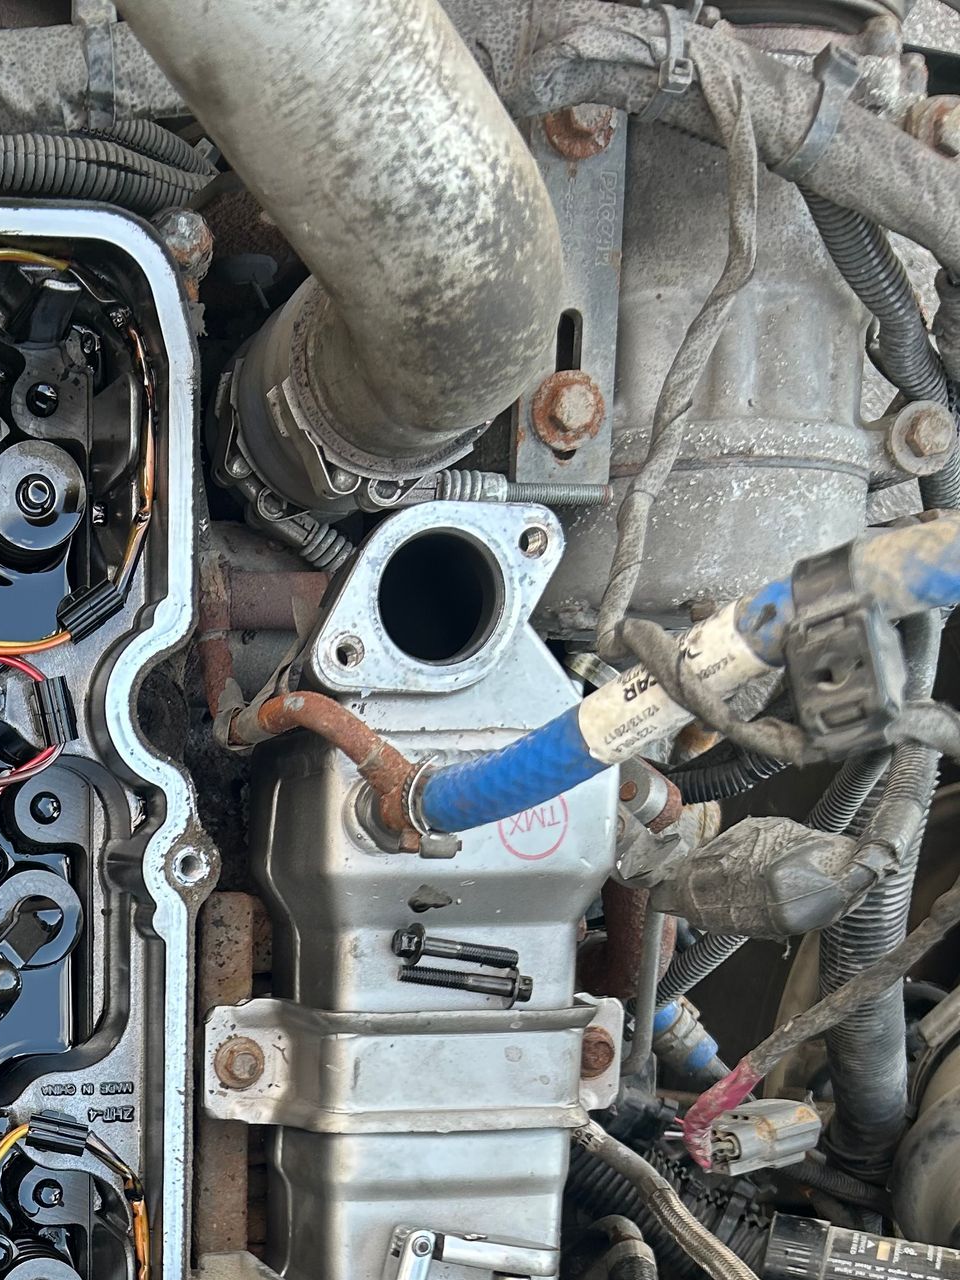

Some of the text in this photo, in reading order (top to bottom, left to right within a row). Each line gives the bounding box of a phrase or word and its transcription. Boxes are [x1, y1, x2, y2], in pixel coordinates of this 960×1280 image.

[603, 704, 660, 745] 12/13/2017
[509, 805, 561, 836] TMX
[41, 1081, 134, 1096] MADE IN CHINA
